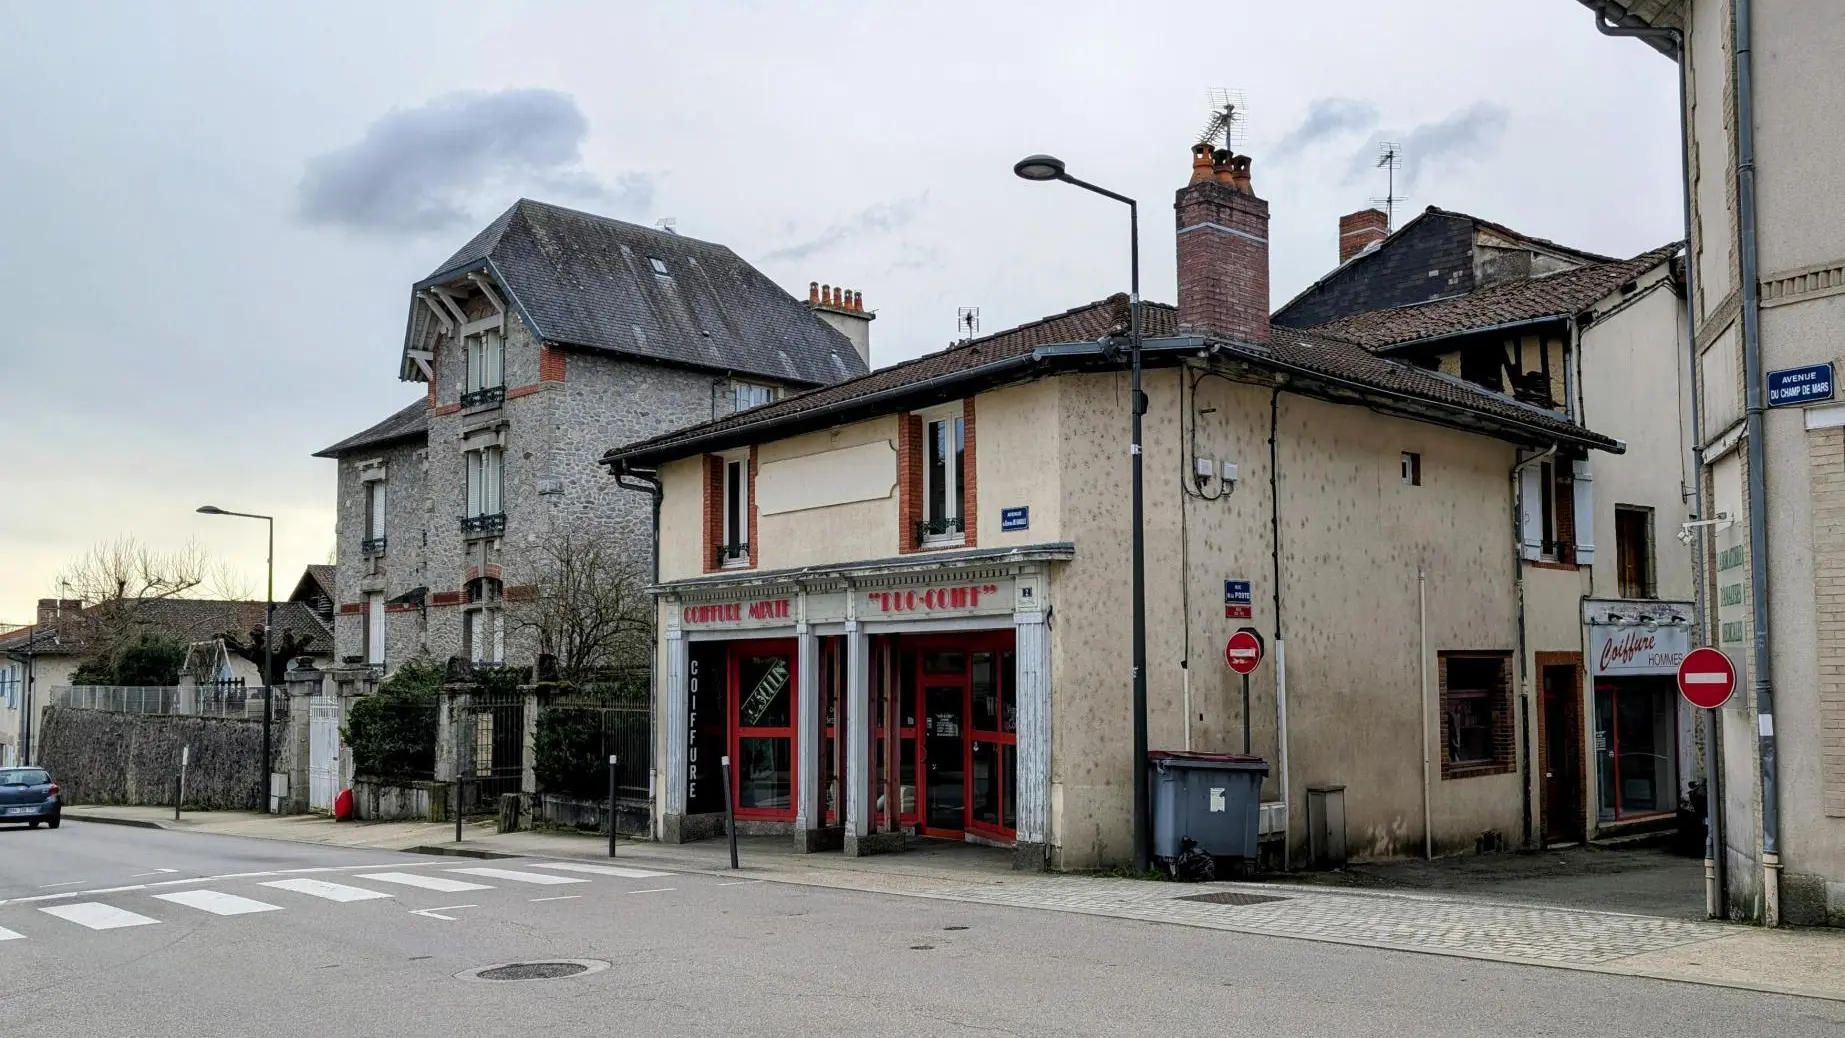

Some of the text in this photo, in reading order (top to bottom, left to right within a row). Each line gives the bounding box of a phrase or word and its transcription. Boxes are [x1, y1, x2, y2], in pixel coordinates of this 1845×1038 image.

[1782, 372, 1817, 384] AVENUE
[1770, 381, 1829, 400] DU CHAMP DE MARS
[683, 599, 790, 624] COIFFURE MIXTE
[1600, 631, 1656, 671] Coiffure
[1648, 653, 1683, 666] HOMMES
[689, 660, 698, 798] COIFFURE
